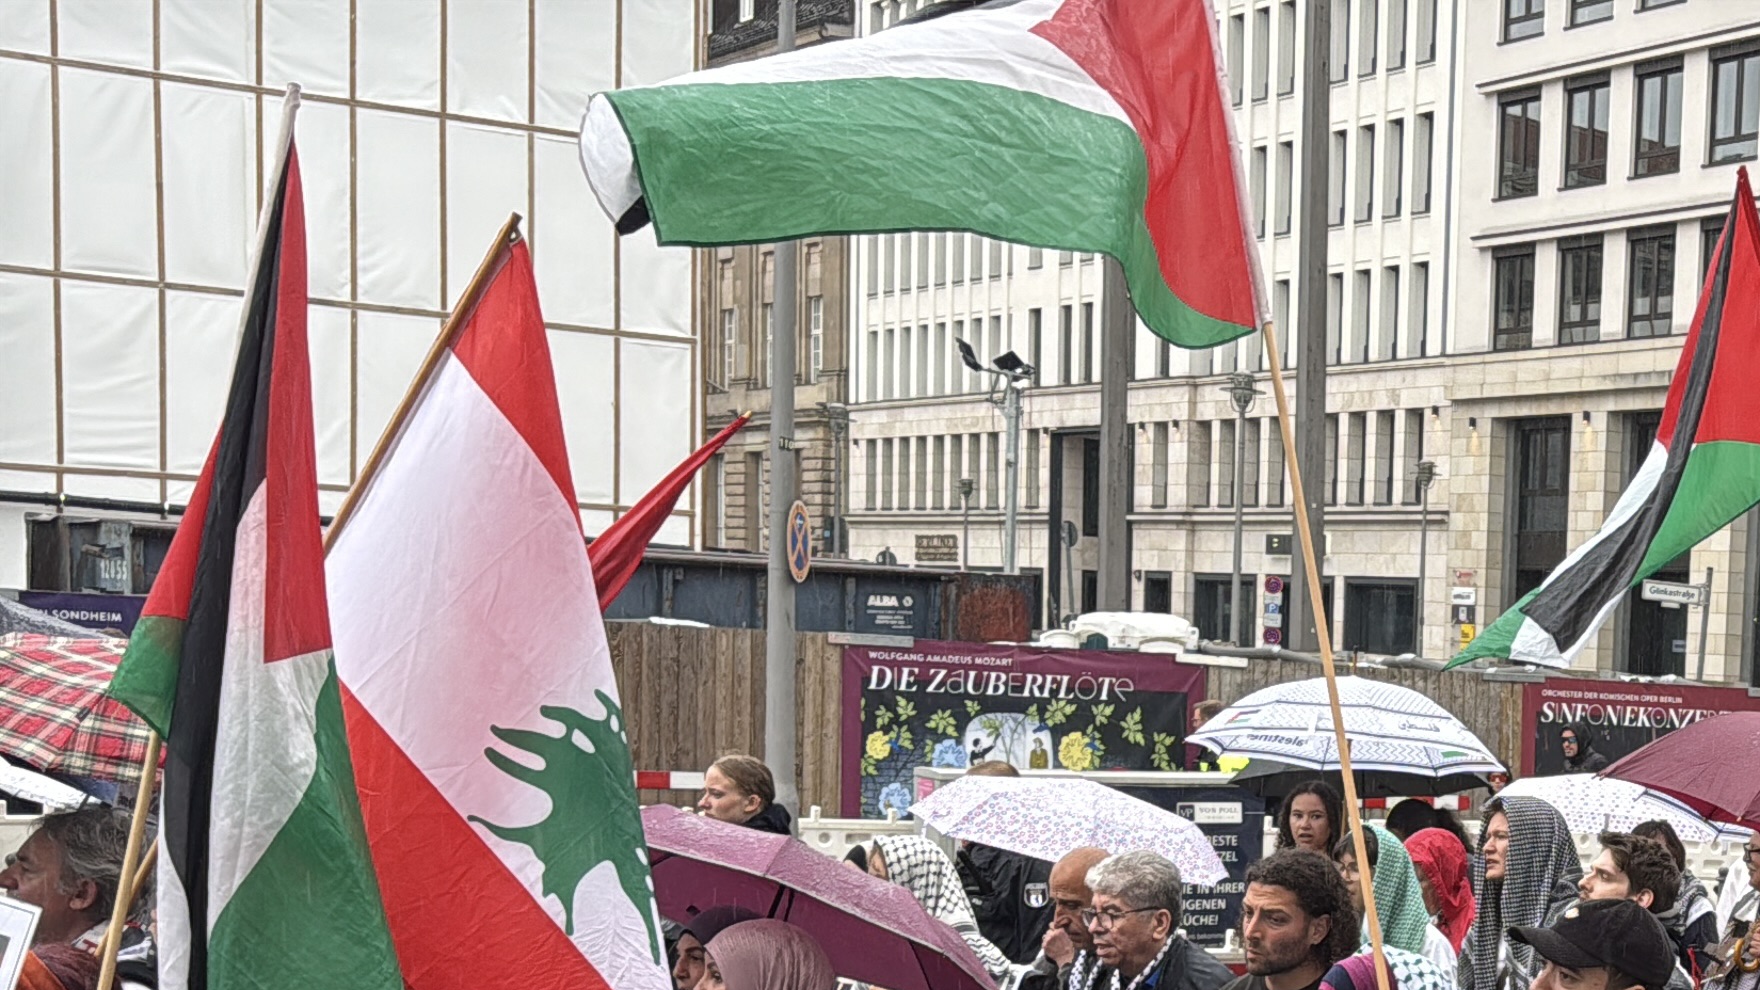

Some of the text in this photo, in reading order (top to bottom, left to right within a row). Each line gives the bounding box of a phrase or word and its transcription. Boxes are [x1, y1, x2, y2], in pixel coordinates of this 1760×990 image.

[867, 595, 899, 607] ALBA
[51, 609, 122, 622] SONDHEIM
[868, 651, 1013, 667] WOLFGANG AMADEUS MOZART
[867, 665, 919, 692] DIE
[1541, 689, 1683, 704] ORCHESTER DER KOMISCHEN OPER BERLIN
[1540, 701, 1733, 729] SINFONIEKONZE
[1182, 898, 1227, 911] IGENEN
[1182, 913, 1219, 926] ÜCHE!
